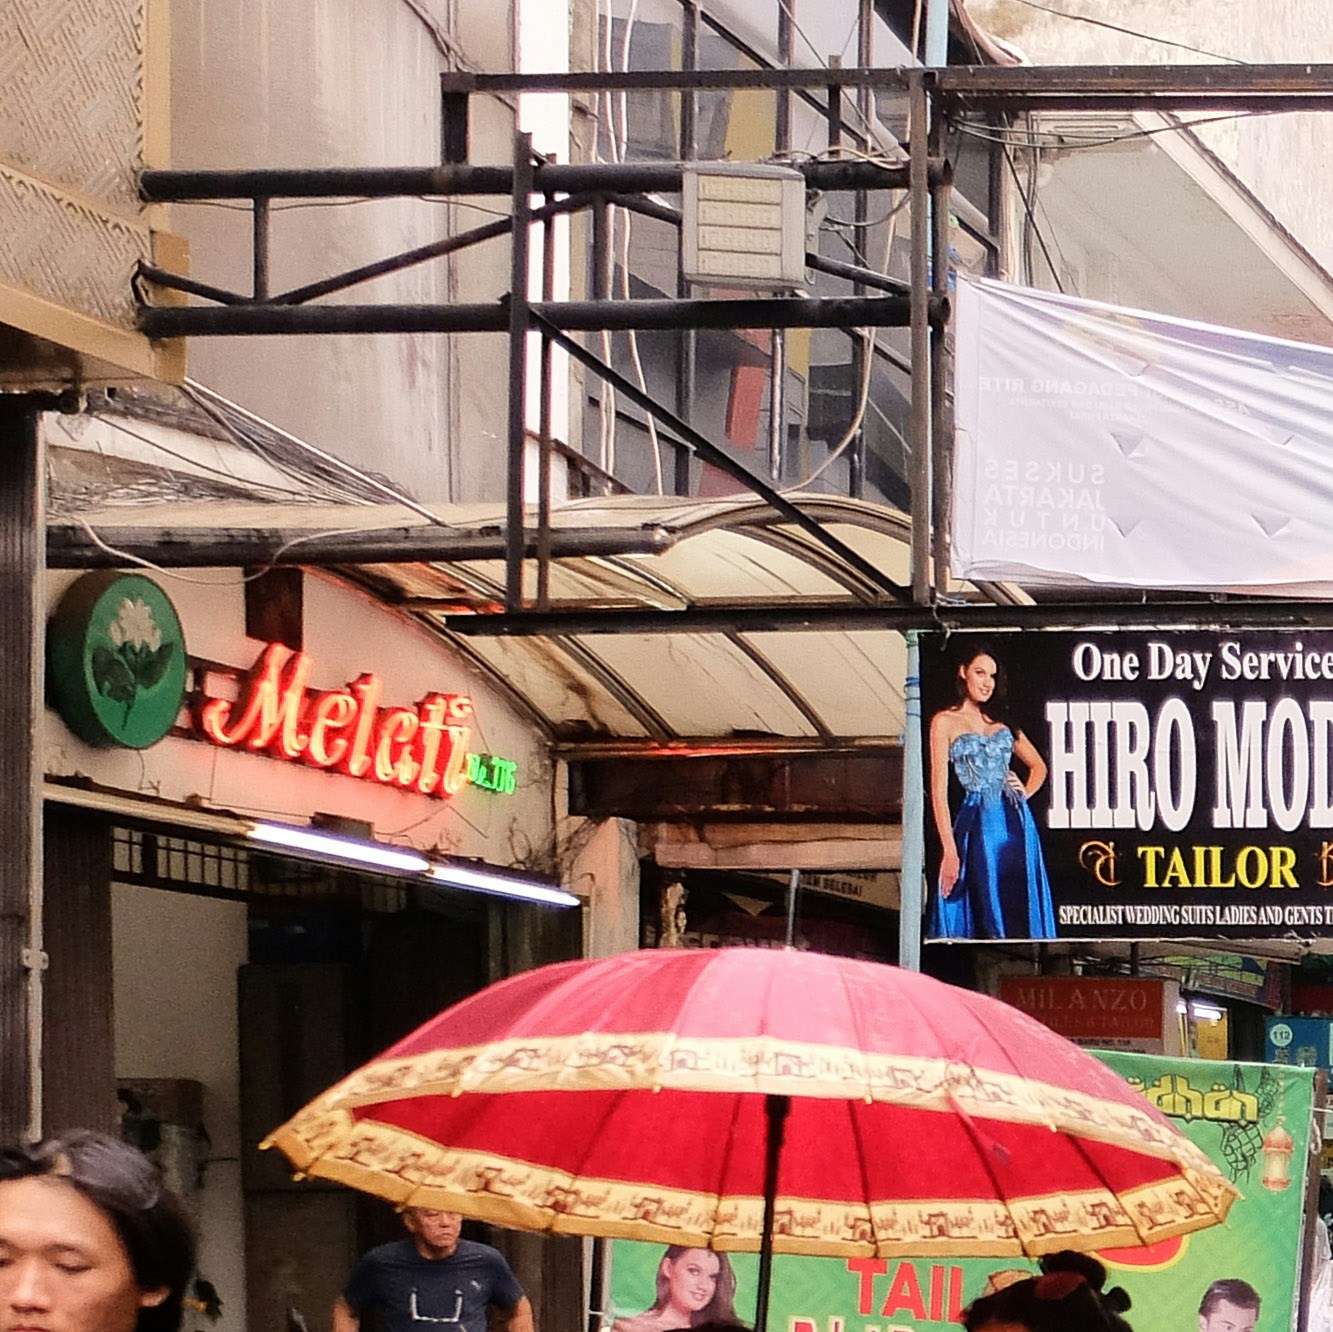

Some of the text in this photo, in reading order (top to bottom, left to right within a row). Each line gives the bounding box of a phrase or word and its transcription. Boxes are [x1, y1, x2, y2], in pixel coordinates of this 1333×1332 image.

[1073, 642, 1141, 681] One
[1147, 643, 1213, 689] Day
[203, 643, 472, 796] Melati
[1045, 697, 1198, 832] HIRO
[1137, 845, 1300, 889] TAILOR
[1059, 905, 1124, 926] SPECIALIST
[1125, 905, 1179, 926] WEDDING
[1180, 905, 1215, 926] SUITS
[1215, 905, 1256, 926] LADIES
[1257, 905, 1282, 926] AND
[1283, 905, 1322, 926] GENTS
[1273, 1030, 1290, 1041] 112
